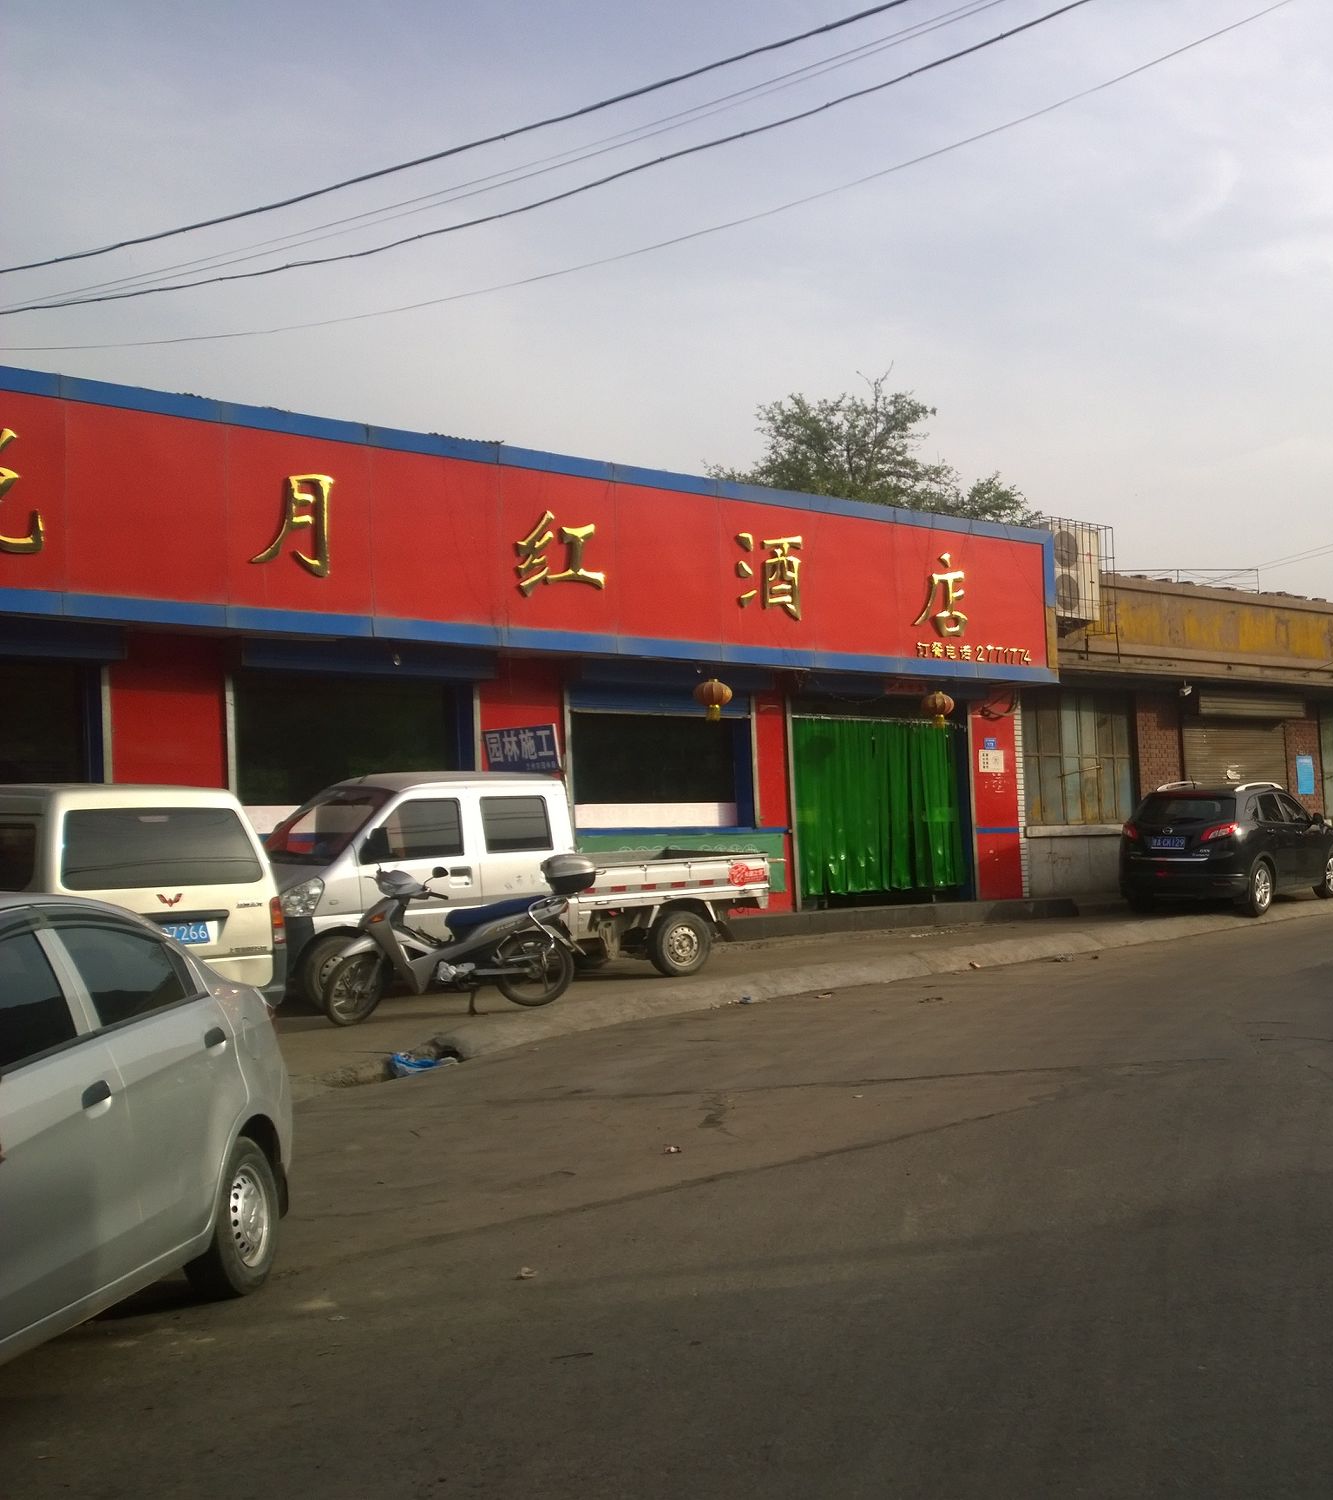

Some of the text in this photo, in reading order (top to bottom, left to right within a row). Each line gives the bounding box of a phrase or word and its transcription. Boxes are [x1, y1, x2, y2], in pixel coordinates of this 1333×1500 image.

[485, 730, 555, 763] 园林施工
[161, 925, 208, 940] 7266
